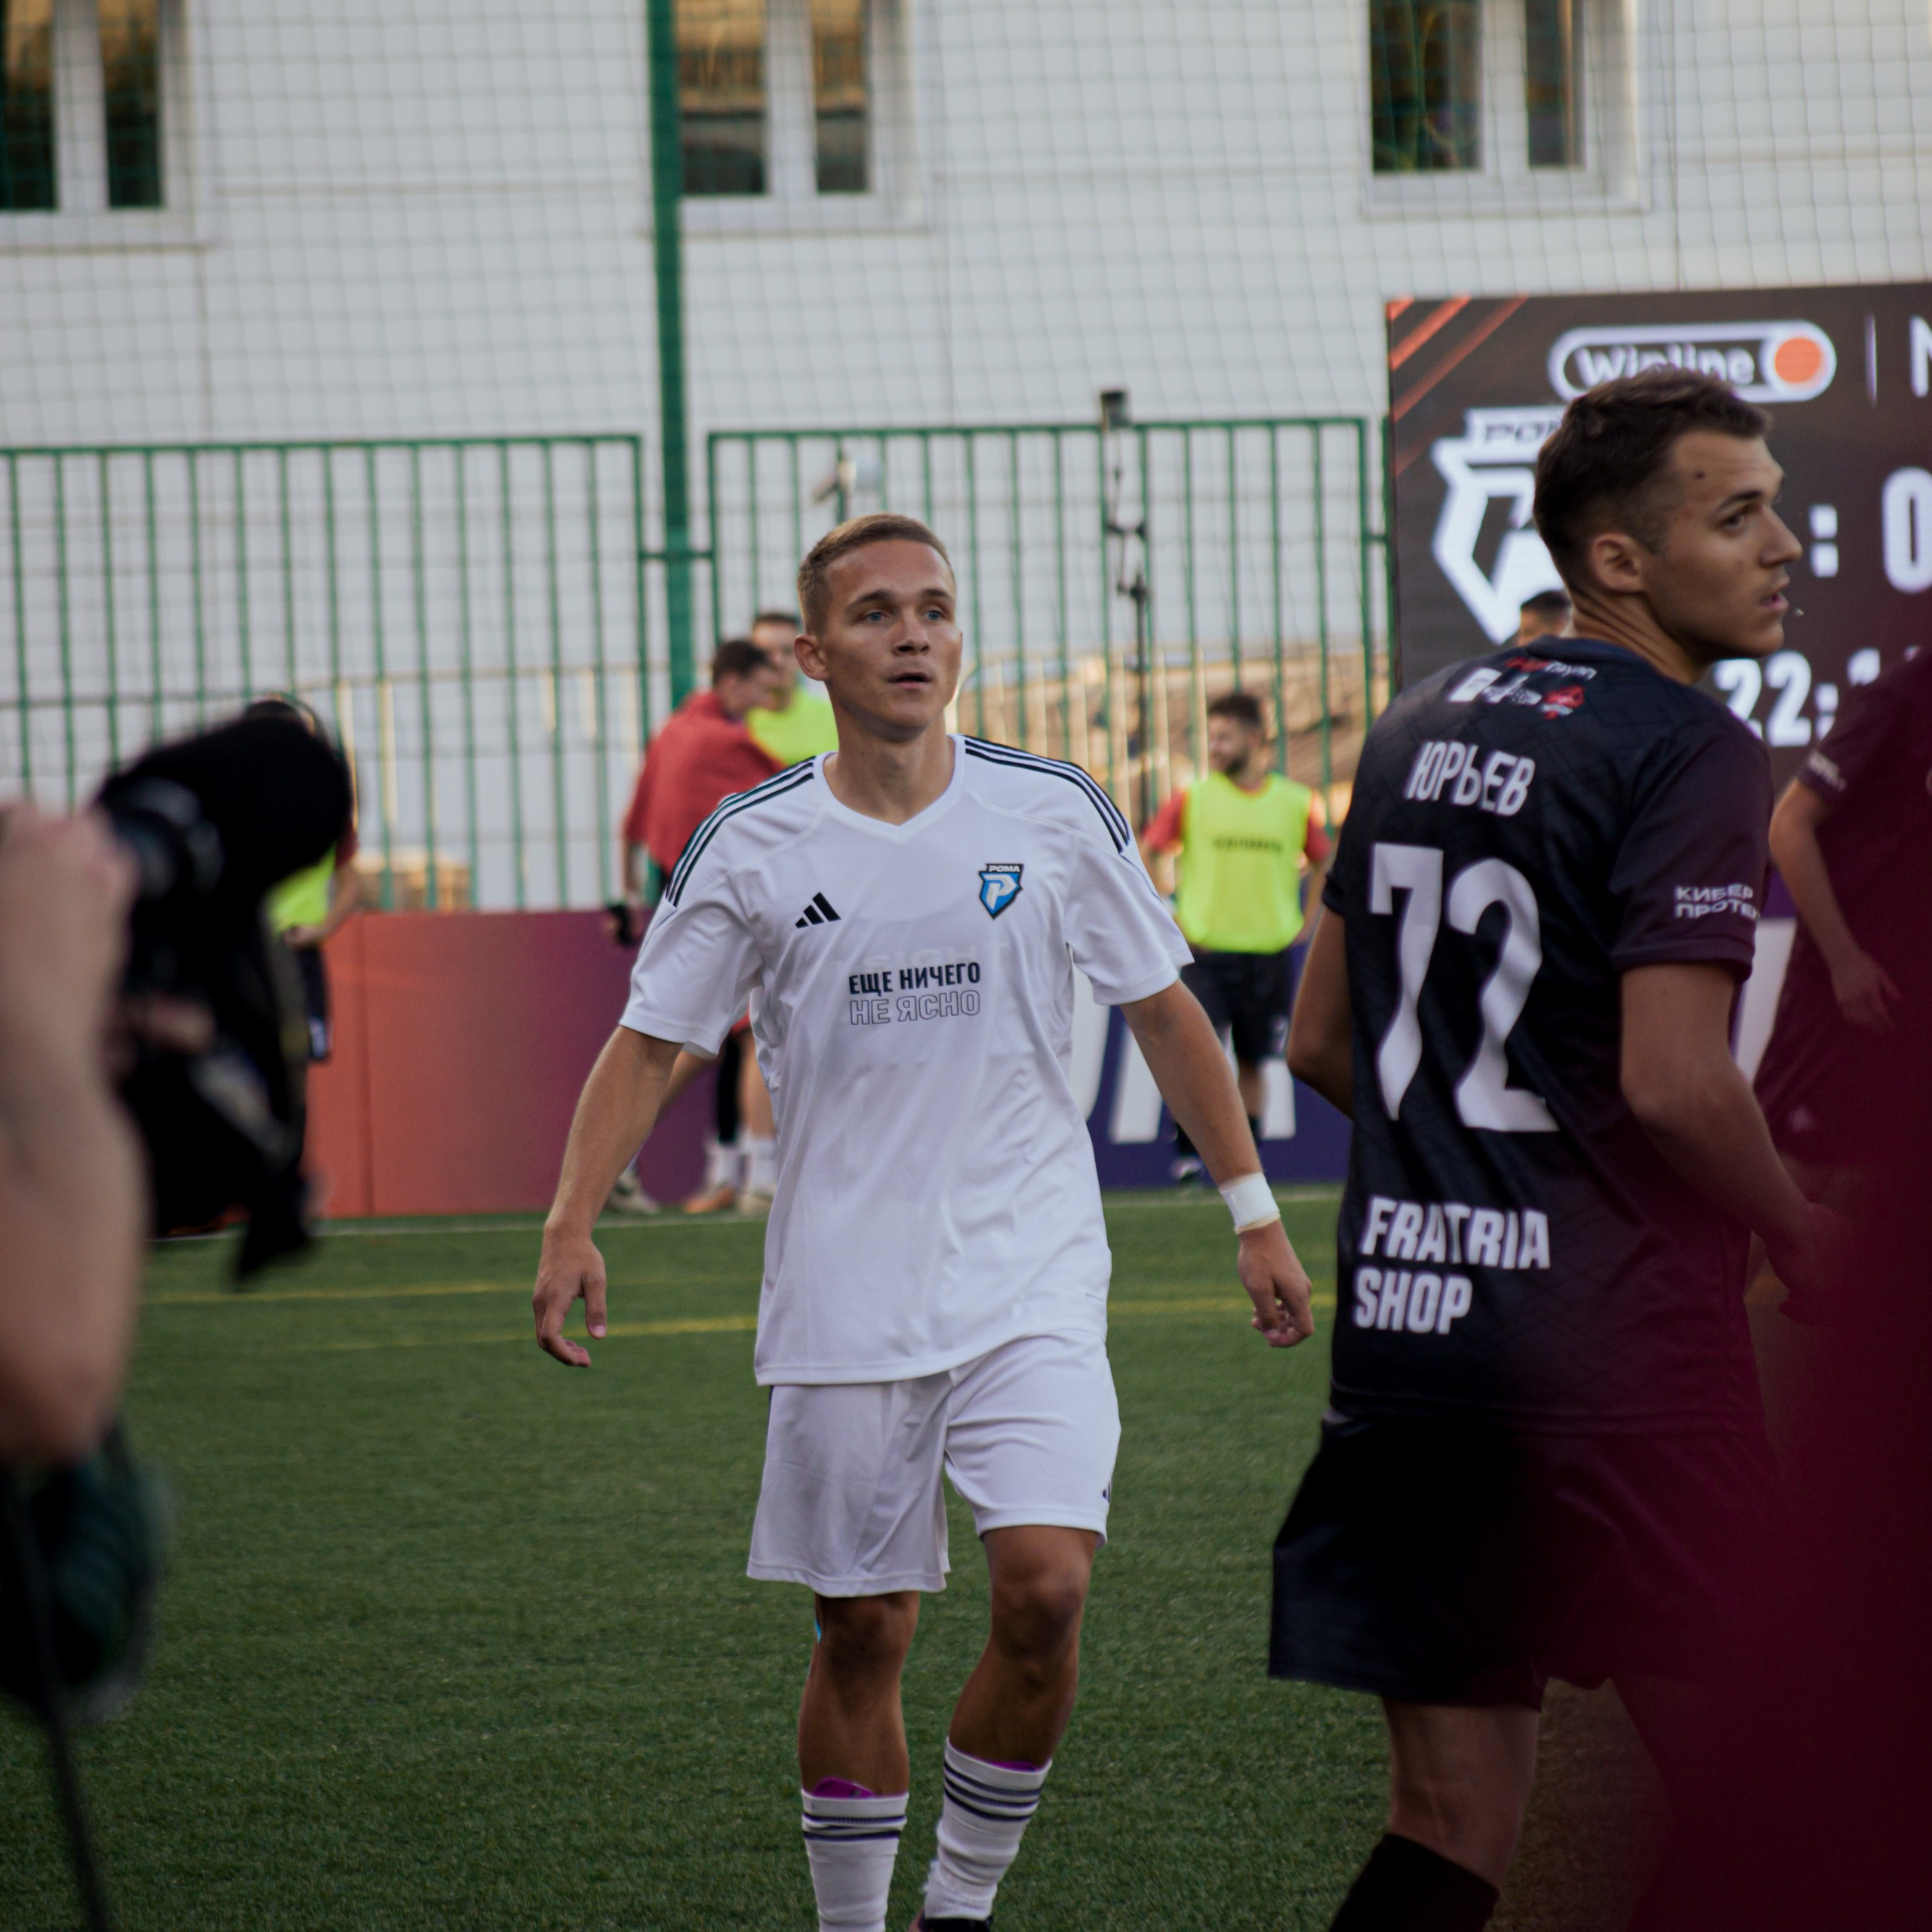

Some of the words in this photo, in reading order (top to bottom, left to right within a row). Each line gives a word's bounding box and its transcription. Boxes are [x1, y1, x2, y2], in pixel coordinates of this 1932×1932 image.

[1404, 740, 1537, 817] ЮРЬЕВ
[1676, 883, 1754, 903] КИБЕР
[848, 971, 894, 997] ЕЩЕ
[899, 961, 981, 990] НИЧЕГО
[850, 998, 891, 1026] НЕ
[896, 989, 981, 1022] ЯСНО
[1370, 841, 1561, 1134] 72
[1361, 1195, 1551, 1271] FRATRIA
[1354, 1266, 1473, 1336] SHOP
